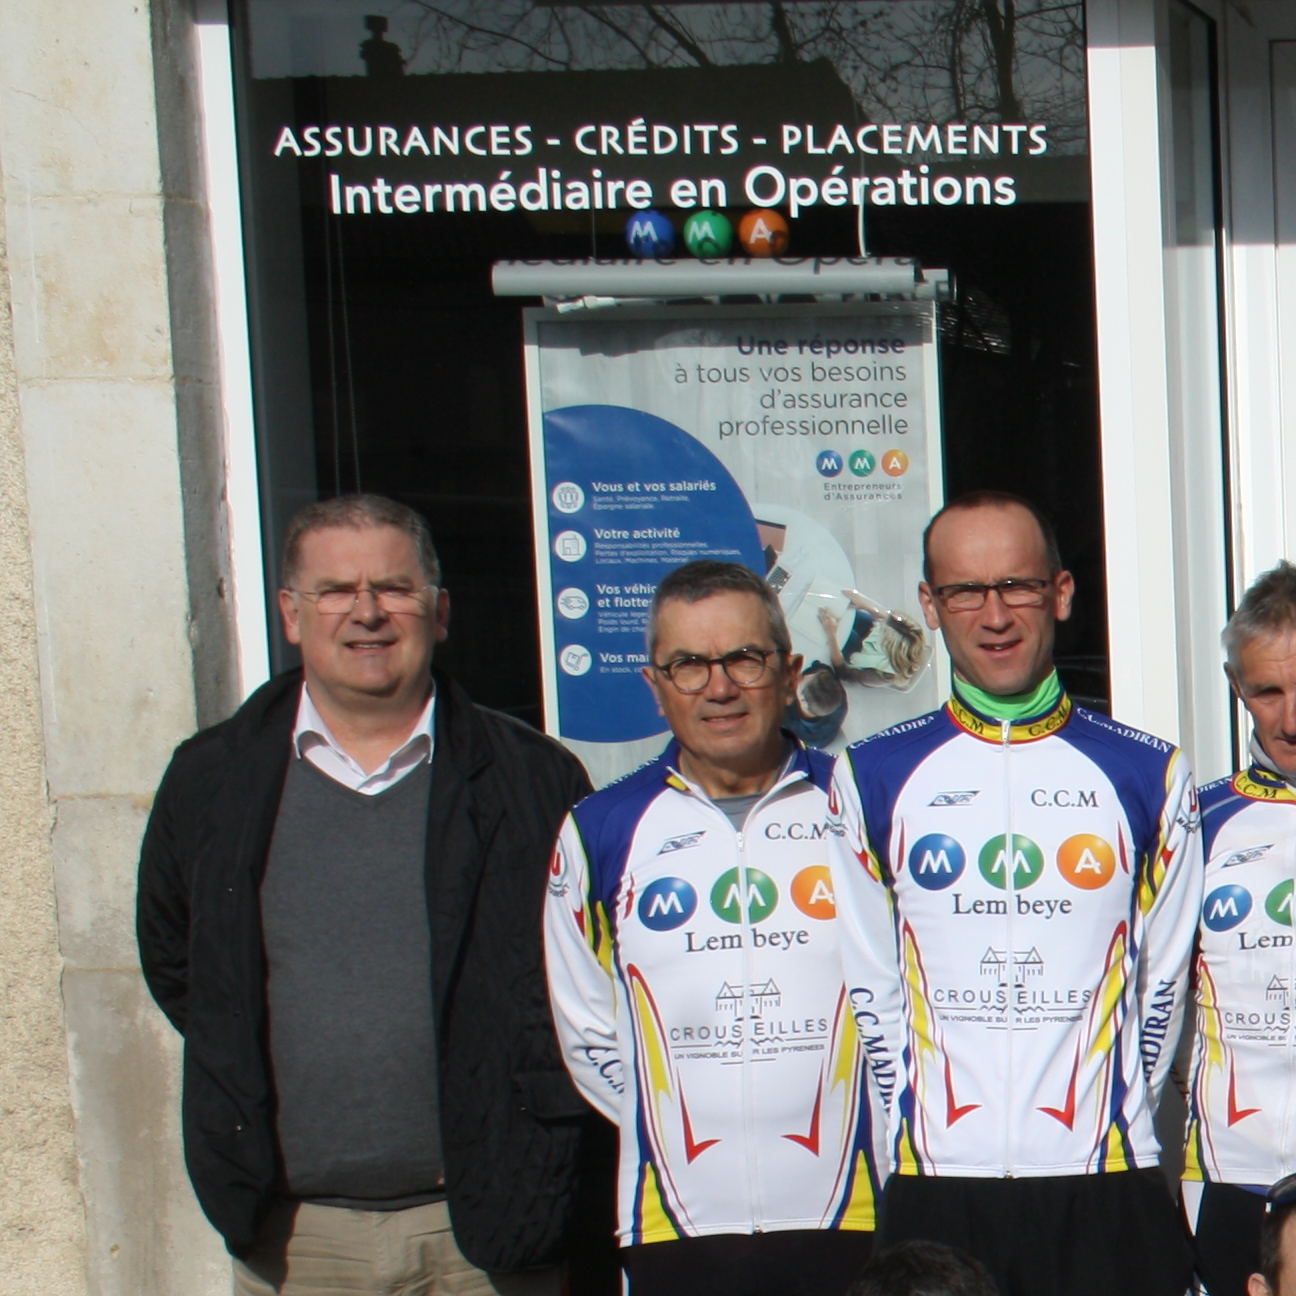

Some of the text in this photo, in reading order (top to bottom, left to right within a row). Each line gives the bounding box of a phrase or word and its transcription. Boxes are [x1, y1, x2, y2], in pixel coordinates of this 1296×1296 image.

[274, 117, 1048, 157] ASSURANCES CRÉDITS PLACEMENTS
[328, 165, 1017, 218] Intermédiaire en Opérations
[737, 334, 905, 358] Une réponse
[674, 362, 906, 383] à tous vos besoins
[760, 388, 908, 409] d'assurance
[719, 414, 909, 440] professionnelle
[592, 482, 624, 492] Vous
[628, 482, 640, 491] et
[670, 480, 717, 491] salariés
[824, 482, 902, 492] Entrepreneurs
[594, 528, 680, 539] Votre activité
[597, 583, 657, 595] Vos véhic
[598, 599, 611, 608] et
[600, 653, 649, 663] Vos ma
[1030, 788, 1100, 809] C.C.M
[951, 893, 1073, 920] Lembeye
[684, 927, 810, 954] Lembeye
[933, 987, 1092, 1006] CROUSEILLES
[670, 1017, 829, 1043] CROUSEILLES
